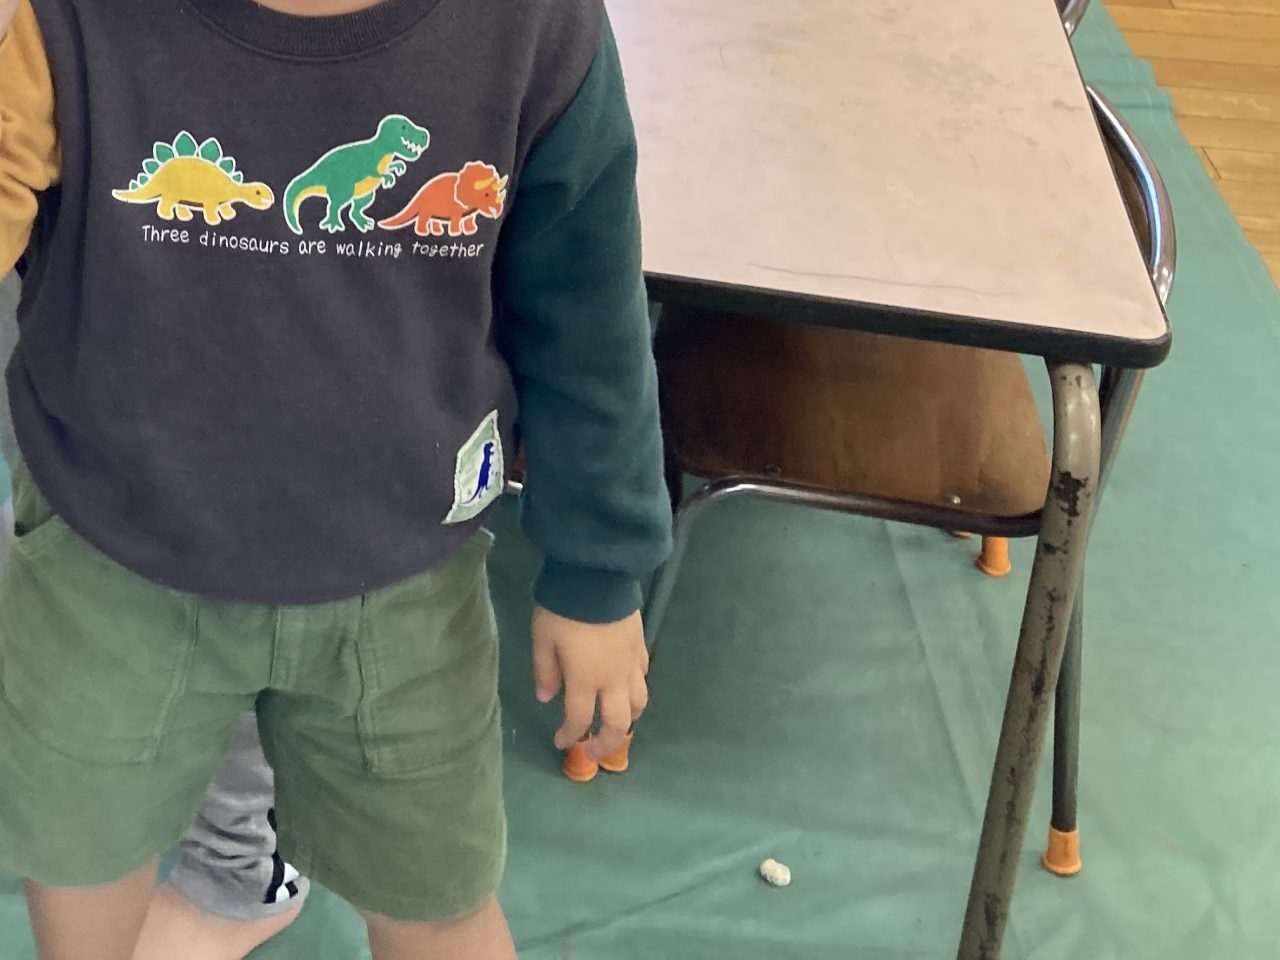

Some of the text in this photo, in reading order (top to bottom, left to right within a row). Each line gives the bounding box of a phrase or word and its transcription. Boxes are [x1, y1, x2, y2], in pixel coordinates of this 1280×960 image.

[142, 225, 485, 258] Three dinosaurs are walking together
